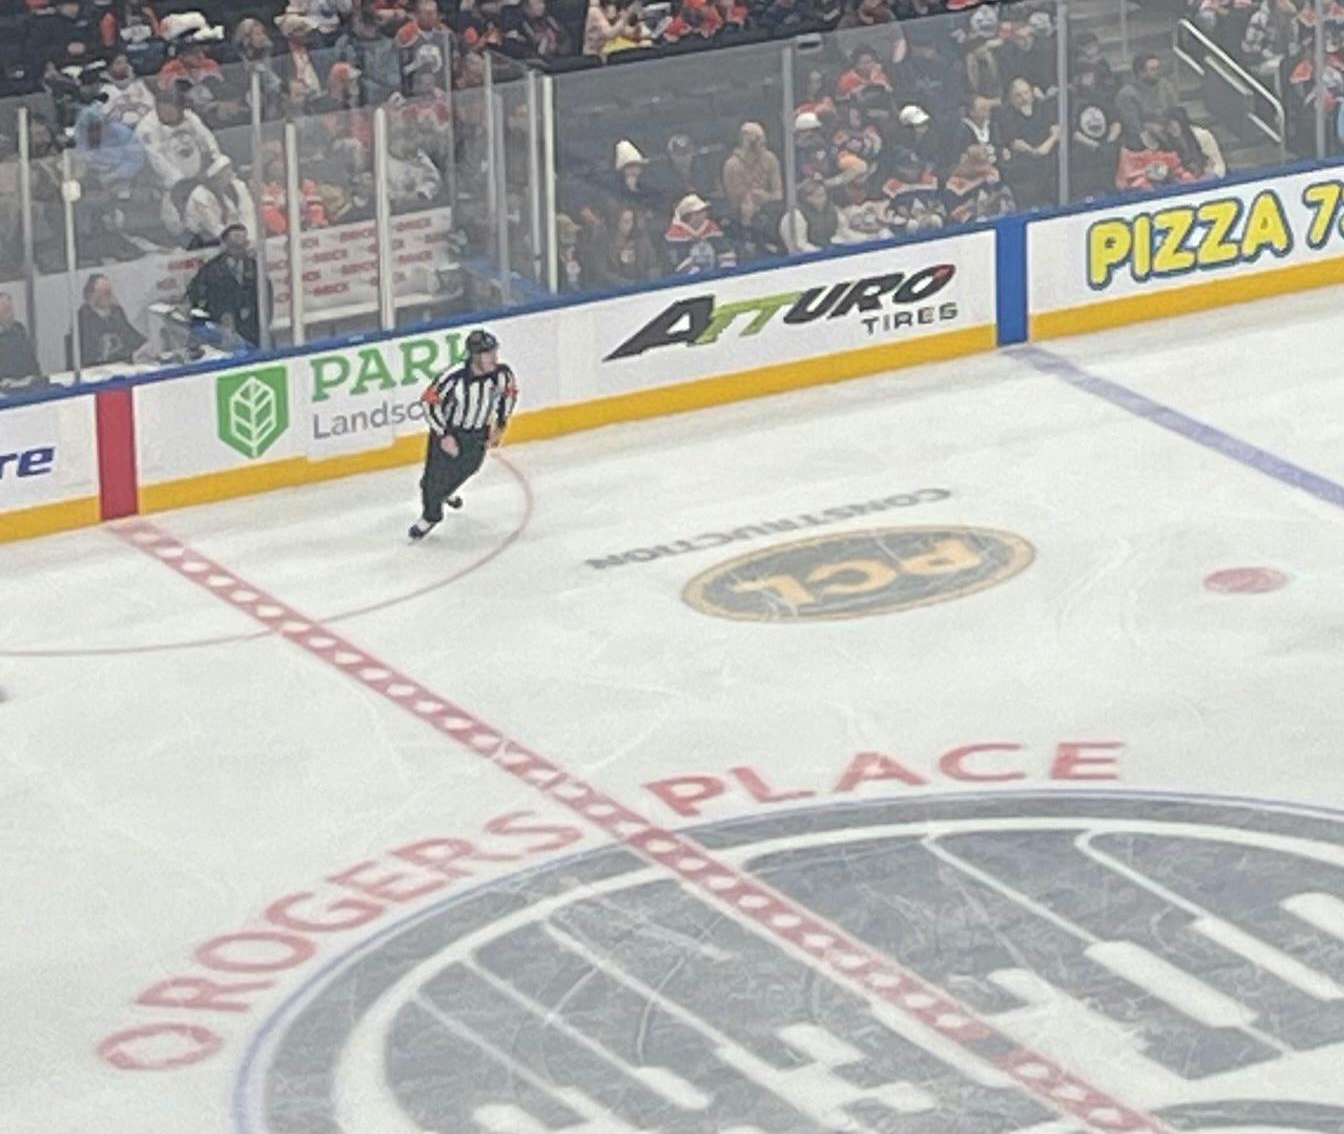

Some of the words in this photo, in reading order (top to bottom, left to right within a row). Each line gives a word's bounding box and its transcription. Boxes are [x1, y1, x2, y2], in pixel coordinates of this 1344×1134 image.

[1087, 190, 1291, 290] PIZZA
[602, 263, 956, 362] ATTURO
[861, 302, 958, 335] TIRES
[641, 740, 1126, 819] PLACE
